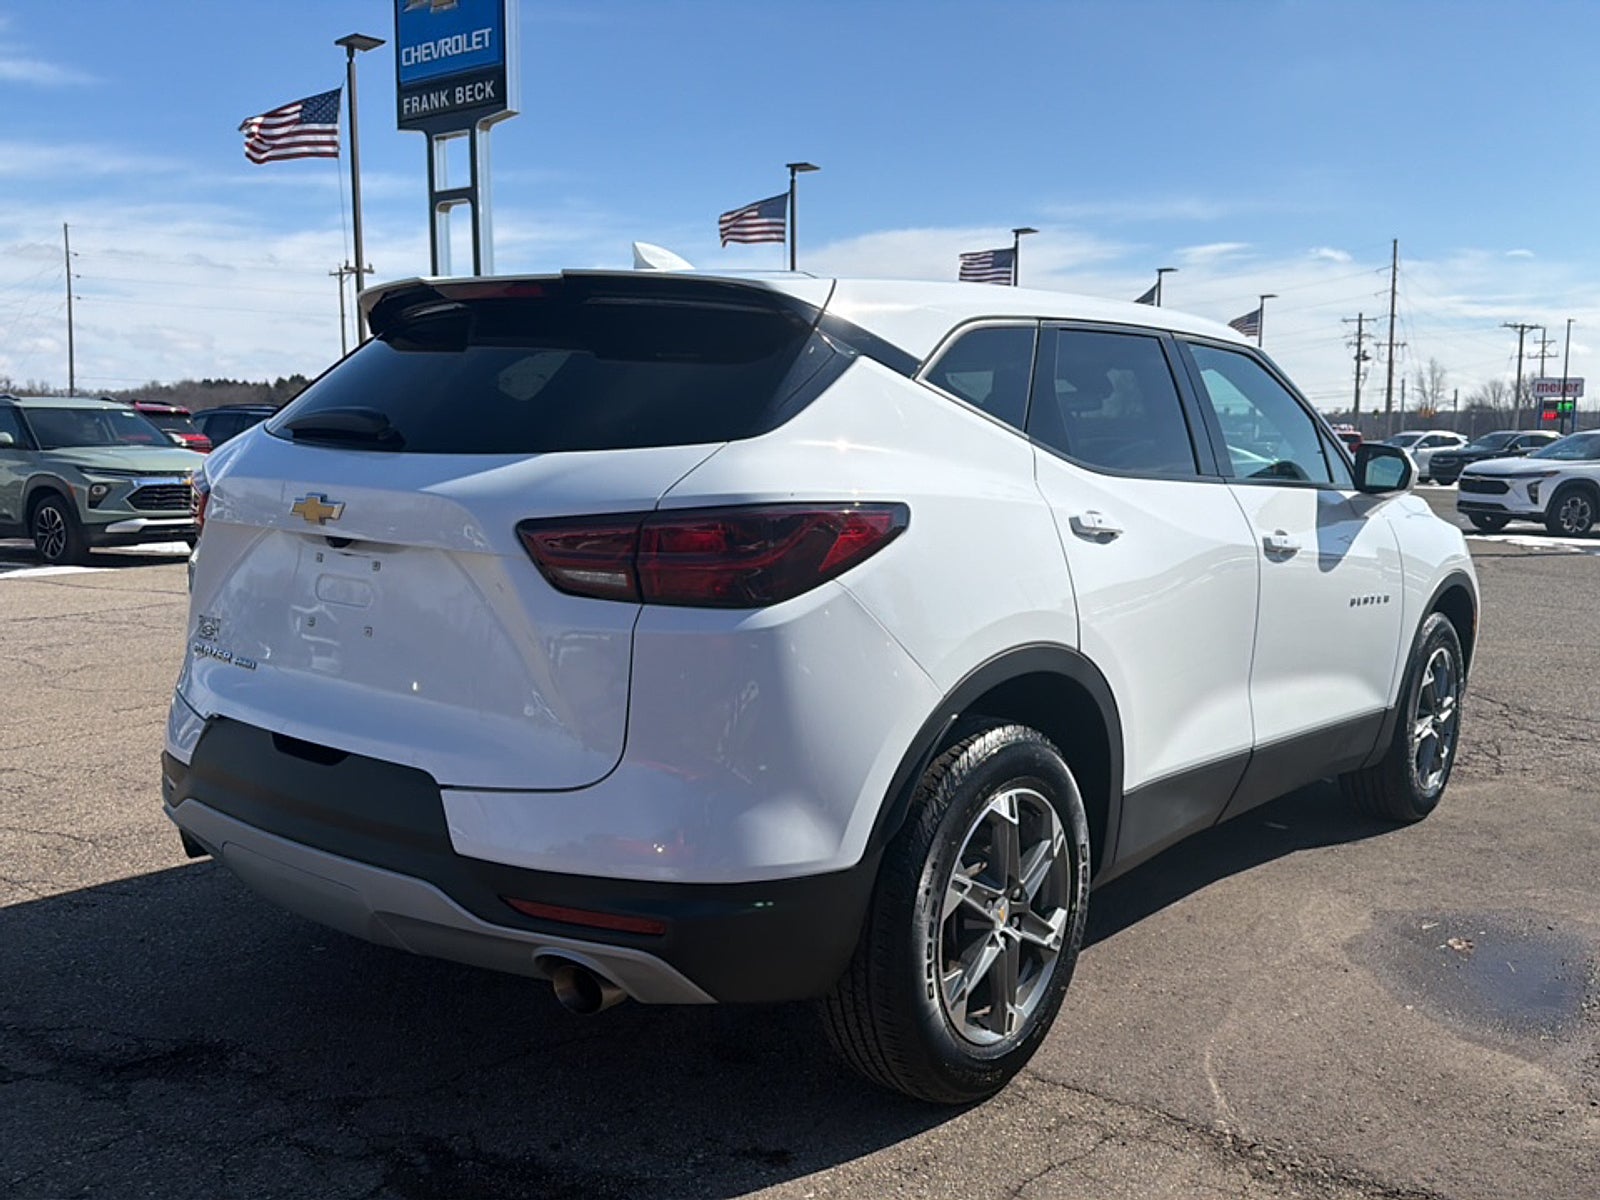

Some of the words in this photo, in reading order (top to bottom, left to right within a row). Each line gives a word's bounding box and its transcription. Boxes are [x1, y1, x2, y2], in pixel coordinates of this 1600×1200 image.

[402, 27, 492, 66] CHEVROLET
[403, 89, 450, 115] FRANK
[455, 80, 495, 105] BECK
